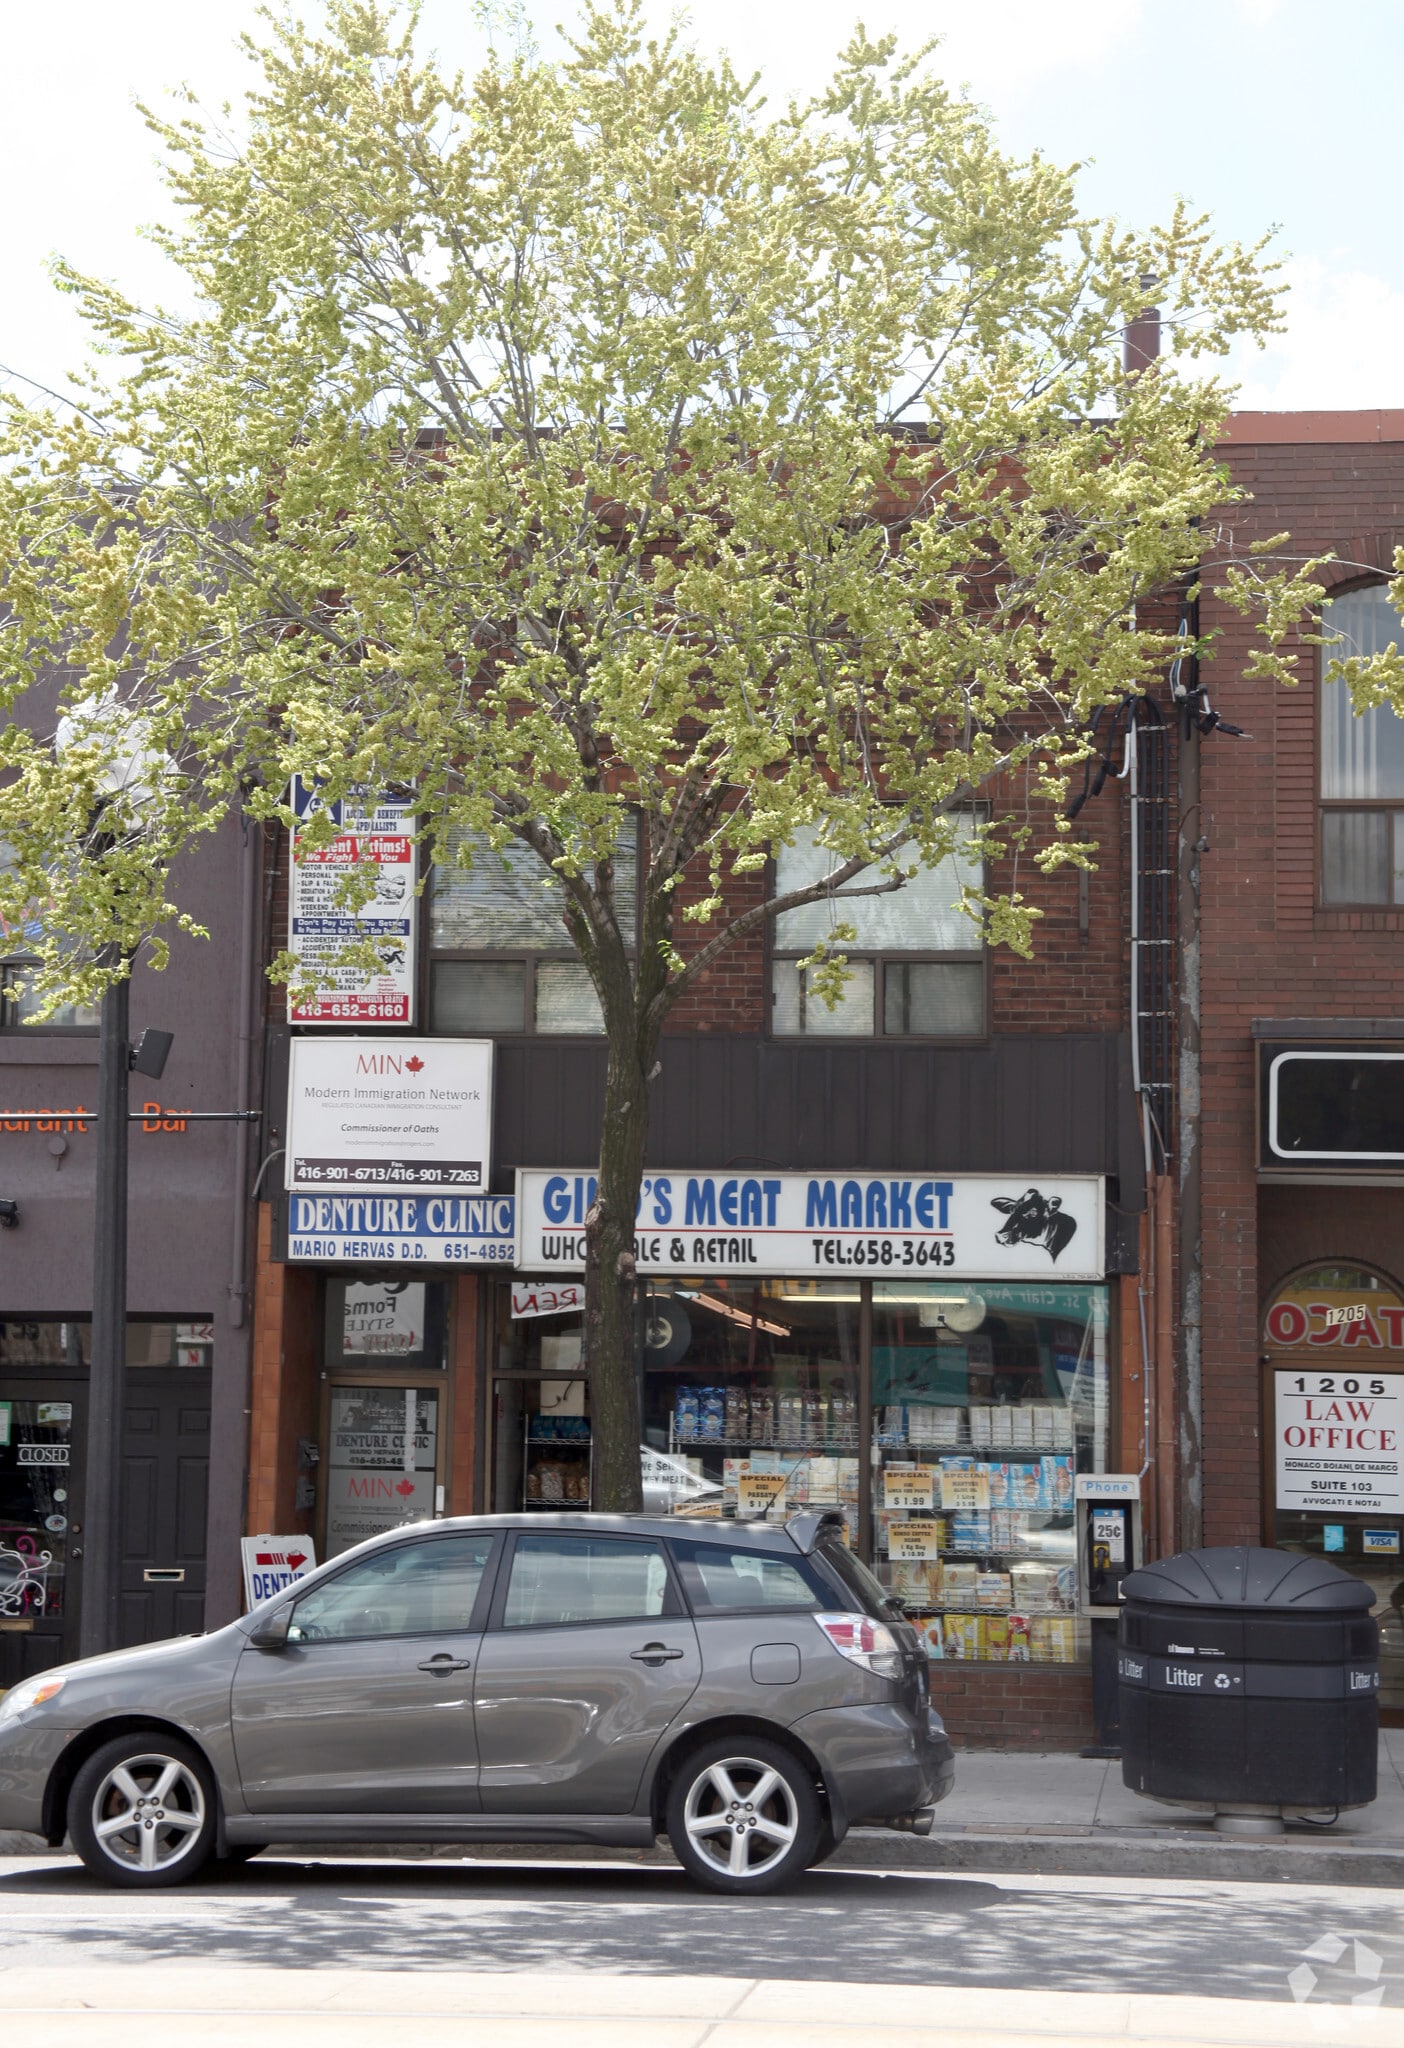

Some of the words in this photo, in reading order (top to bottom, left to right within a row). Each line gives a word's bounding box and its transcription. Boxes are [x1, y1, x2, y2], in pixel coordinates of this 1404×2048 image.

[378, 810, 406, 819] BENEFIT
[356, 838, 406, 854] Vctims!
[326, 854, 353, 862] Fight
[297, 1004, 404, 1017] 416-652-6160
[356, 1054, 402, 1075] MIN
[304, 1087, 350, 1099] Modern
[354, 1088, 426, 1101] Immigration
[430, 1088, 480, 1100] Network
[0, 1104, 88, 1132] urant
[143, 1102, 192, 1132] Bar
[341, 1123, 402, 1134] Commissioner
[402, 1124, 413, 1134] of
[414, 1124, 440, 1134] Oaths
[543, 1176, 672, 1225] GI'S
[684, 1178, 782, 1226] MEAT
[806, 1180, 954, 1229] MARKET
[296, 1198, 418, 1232] DENTURE
[426, 1200, 512, 1234] CLINIC
[293, 1240, 336, 1257] MARIO
[344, 1242, 394, 1258] HERVAS
[402, 1243, 427, 1259] D.D.
[444, 1244, 514, 1260] 651-4852
[670, 1238, 686, 1262] &
[692, 1238, 758, 1263] RETAIL
[812, 1239, 955, 1266] TEL:658-3643
[1328, 1306, 1364, 1324] 1205
[1295, 1377, 1385, 1395] 1205
[1304, 1399, 1376, 1422] LAW
[336, 1434, 388, 1448] DENTURE
[1284, 1426, 1396, 1451] OFFICE
[20, 1448, 69, 1462] CLOSED
[656, 1462, 675, 1471] Sel
[1285, 1461, 1321, 1469] MONACO
[348, 1478, 393, 1498] MIN
[1086, 1482, 1128, 1492] Phone
[1311, 1480, 1346, 1490] SUITE
[1352, 1482, 1372, 1492] 103
[904, 1496, 925, 1506] 1.99
[1302, 1498, 1345, 1506] AVVOCATI
[1097, 1524, 1121, 1538] 25¢
[1370, 1537, 1392, 1546] VISA
[253, 1570, 304, 1600] DENTU
[1125, 1659, 1144, 1680] Litter
[1166, 1666, 1204, 1687] Litter
[1350, 1671, 1371, 1690] Litter
